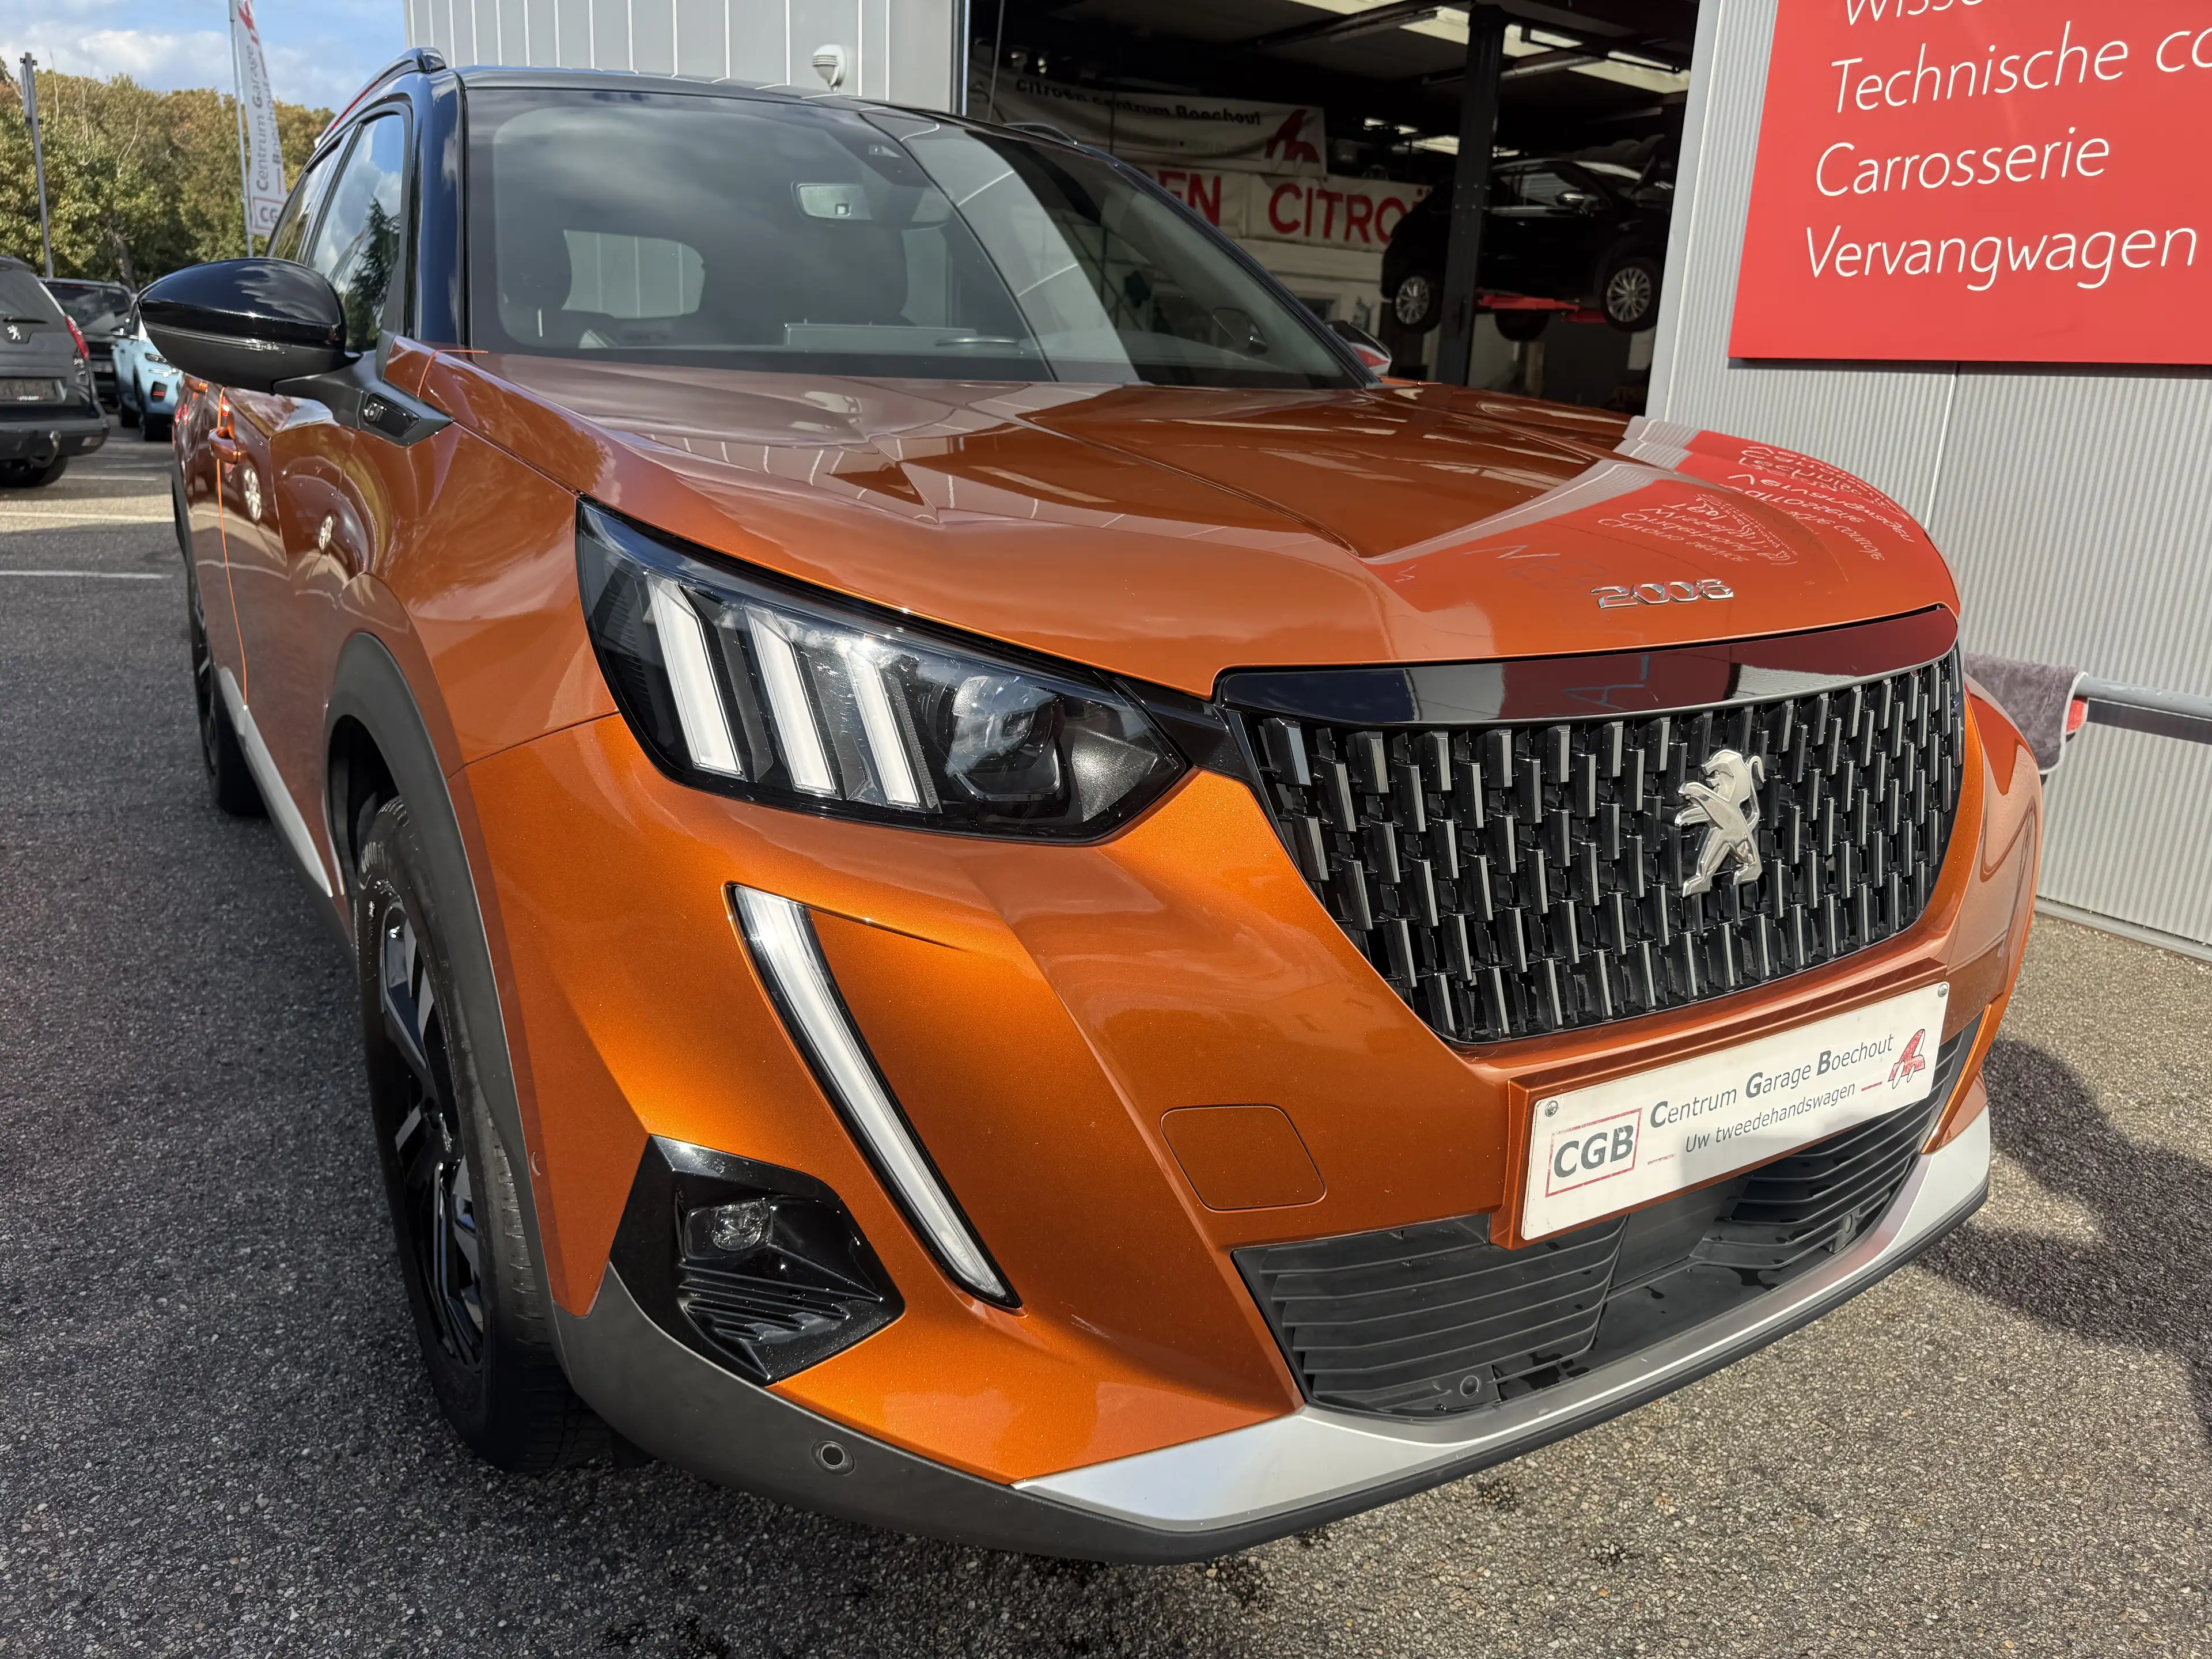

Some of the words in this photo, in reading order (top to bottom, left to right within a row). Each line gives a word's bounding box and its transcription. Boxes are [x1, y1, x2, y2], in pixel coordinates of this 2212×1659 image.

[1831, 21, 2128, 113] Technische
[256, 115, 270, 192] Centrum
[1815, 126, 2109, 196] Carrosserie
[1268, 182, 1431, 245] CITRO
[1806, 225, 2198, 291] Vervangwagen
[1590, 578, 1734, 609] 2008
[1650, 1087, 1737, 1129] Centrum
[1745, 1063, 1812, 1100] Garage
[1816, 1033, 1894, 1077] Boechout
[1554, 1124, 1634, 1179] CGB
[1685, 1130, 1710, 1153] Uw
[1715, 1082, 1855, 1142] tweedehandswagen
